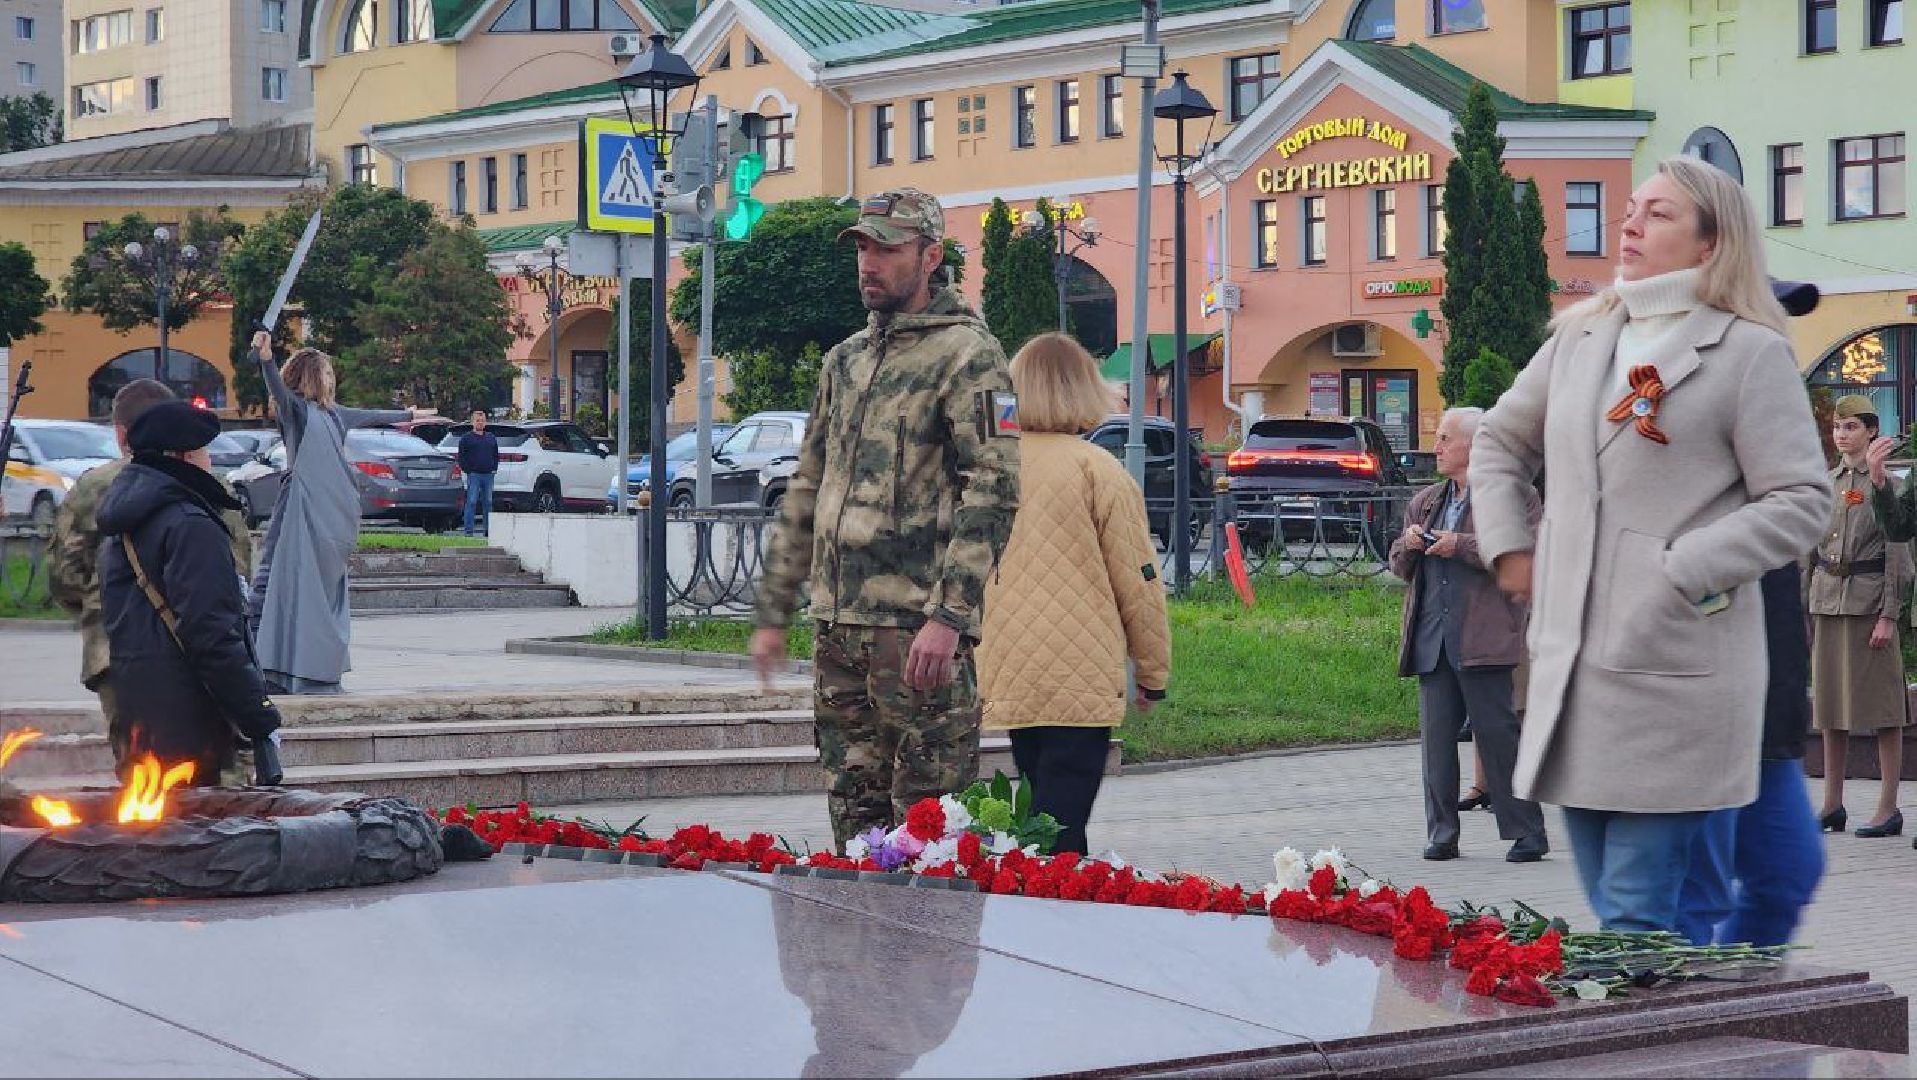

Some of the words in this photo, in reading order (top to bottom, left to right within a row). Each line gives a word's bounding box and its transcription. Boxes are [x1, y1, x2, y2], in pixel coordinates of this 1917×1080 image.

[1277, 117, 1366, 159] ТОРГОВЫЙ
[1367, 120, 1408, 150] ДОМ
[1257, 152, 1431, 193] СЕРГИЕВСКИЙ
[1366, 280, 1431, 294] ОРТОМОДА
